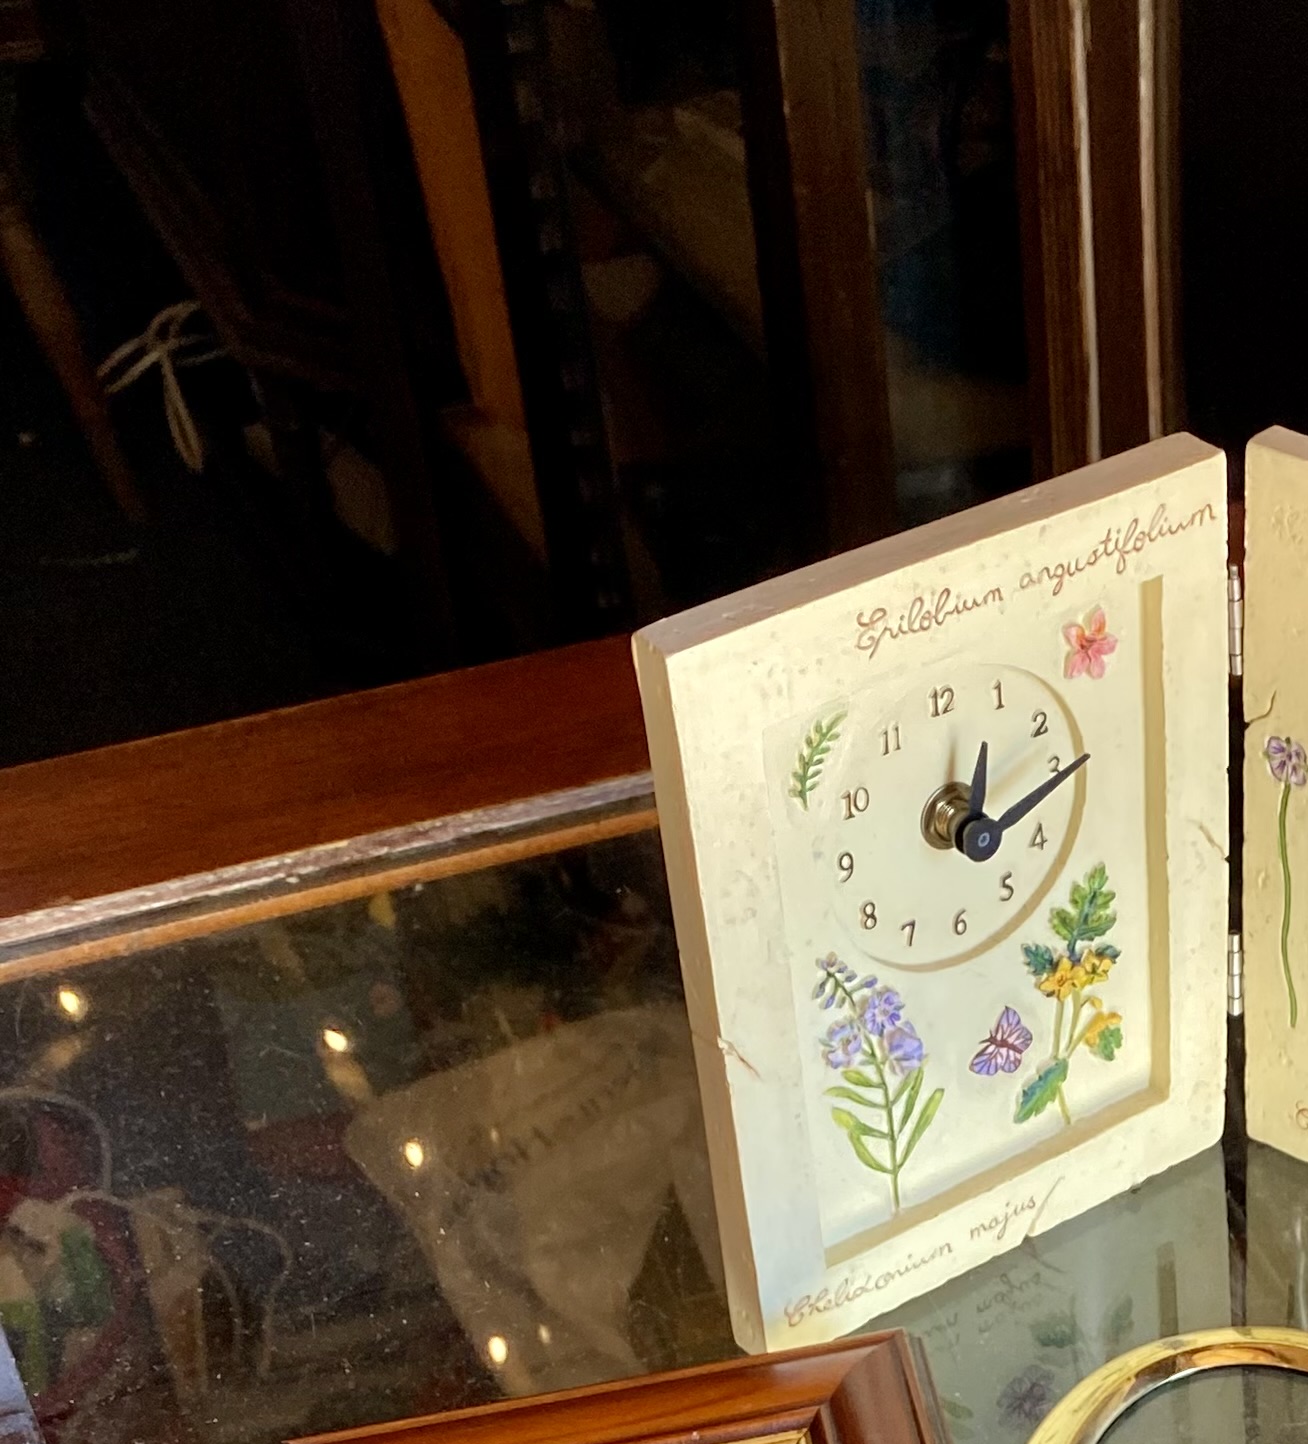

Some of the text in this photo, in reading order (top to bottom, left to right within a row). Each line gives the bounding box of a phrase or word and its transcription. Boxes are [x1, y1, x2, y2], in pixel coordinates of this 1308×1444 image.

[1019, 503, 1217, 597] angustifolium
[929, 685, 955, 718] 12
[994, 679, 1005, 710] 1
[881, 724, 901, 756] 11
[1031, 711, 1049, 738] 2
[841, 787, 870, 821] 10
[1029, 822, 1048, 850] 4
[839, 852, 855, 883] 9
[1000, 871, 1014, 901] 5
[860, 902, 878, 930] 8
[953, 909, 967, 935] 6
[901, 919, 916, 947] 7
[970, 1195, 1036, 1241] majus
